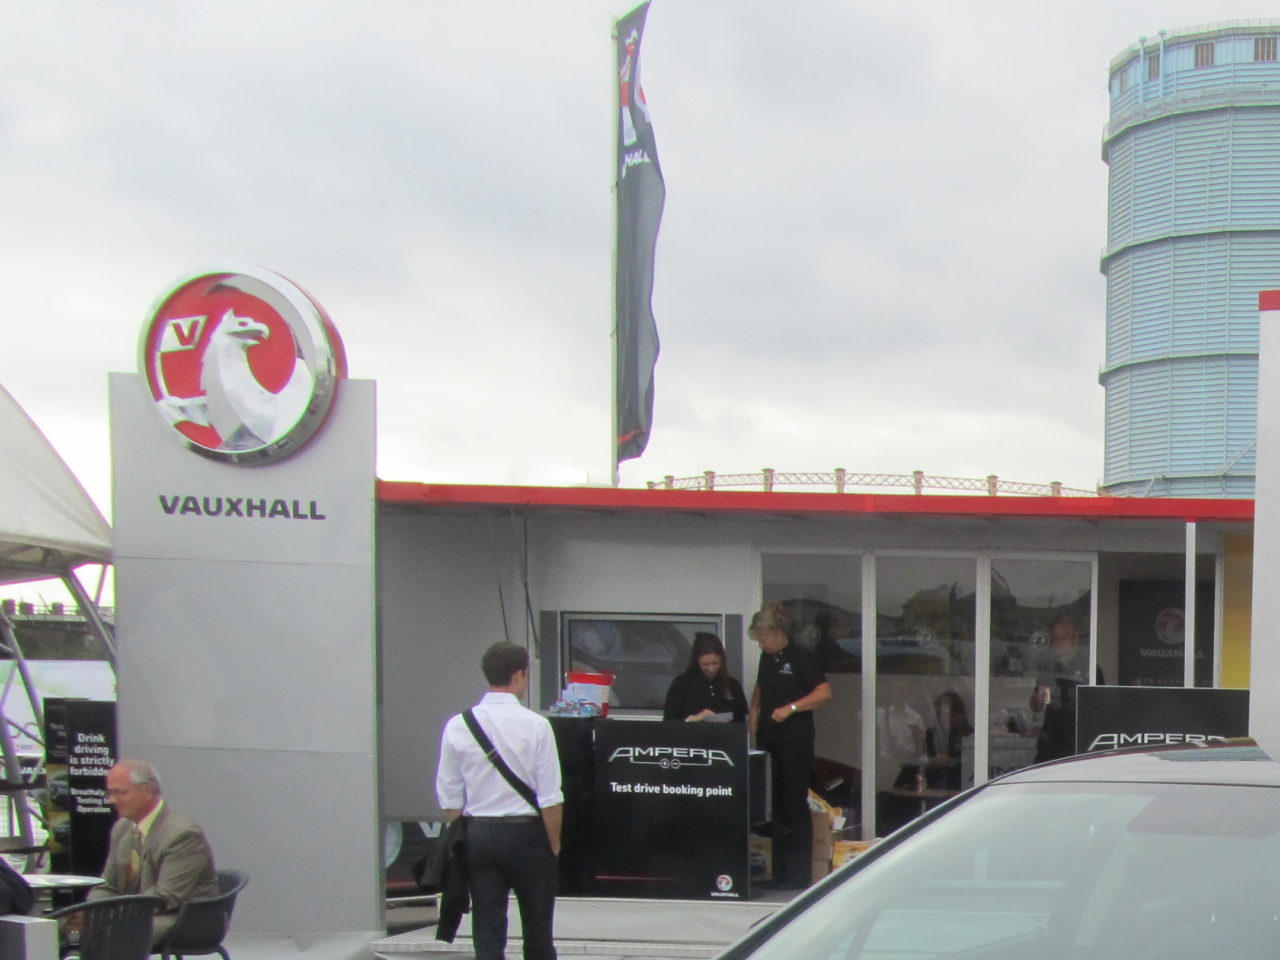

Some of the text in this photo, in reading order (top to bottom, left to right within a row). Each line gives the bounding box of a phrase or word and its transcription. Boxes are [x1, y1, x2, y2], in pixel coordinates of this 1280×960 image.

[158, 494, 326, 520] VAUXHALL
[1140, 648, 1206, 658] VAUXHL
[77, 733, 105, 743] Drink
[1088, 733, 1227, 751] AMPER
[74, 745, 109, 755] driving
[69, 755, 115, 766] is strictly
[607, 746, 735, 766] AMPERA
[70, 767, 109, 776] forbidde
[610, 782, 733, 797] Test drive booking point
